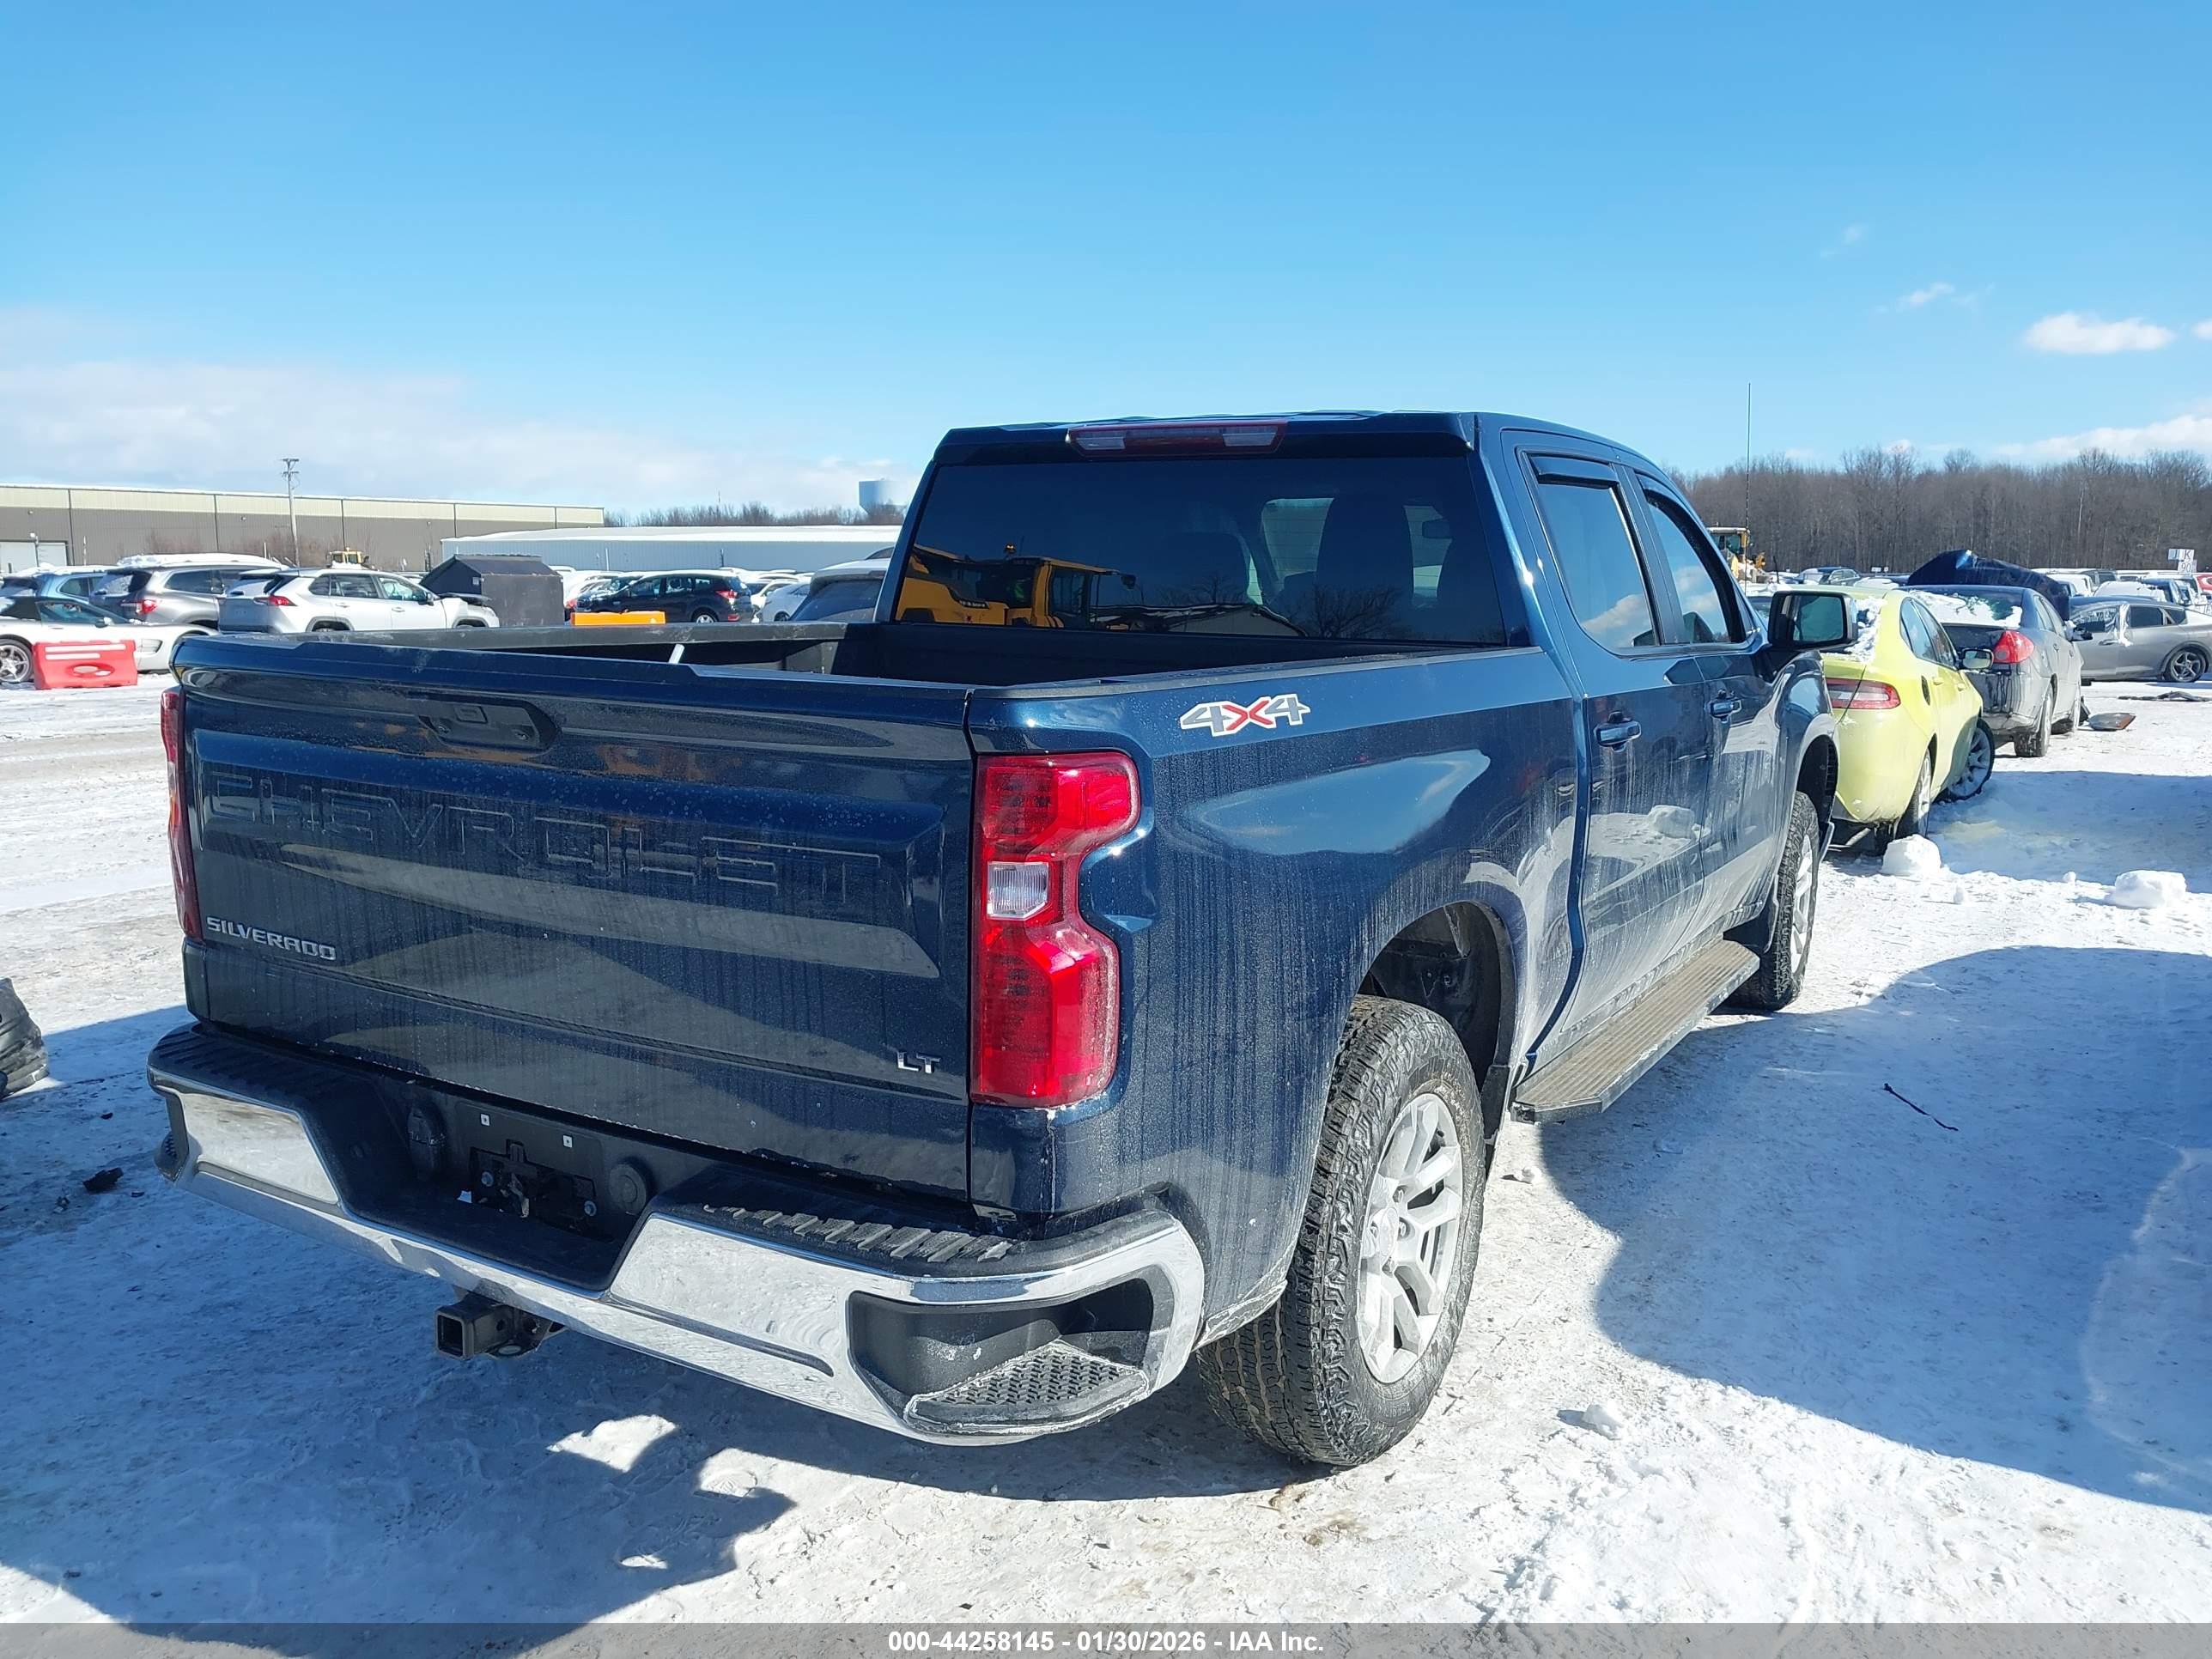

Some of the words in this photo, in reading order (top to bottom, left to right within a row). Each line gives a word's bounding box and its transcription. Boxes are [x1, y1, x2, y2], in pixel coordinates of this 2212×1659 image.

[209, 771, 883, 904] CHEVROLET
[206, 916, 337, 960] SILVERADO
[896, 1051, 941, 1073] LT
